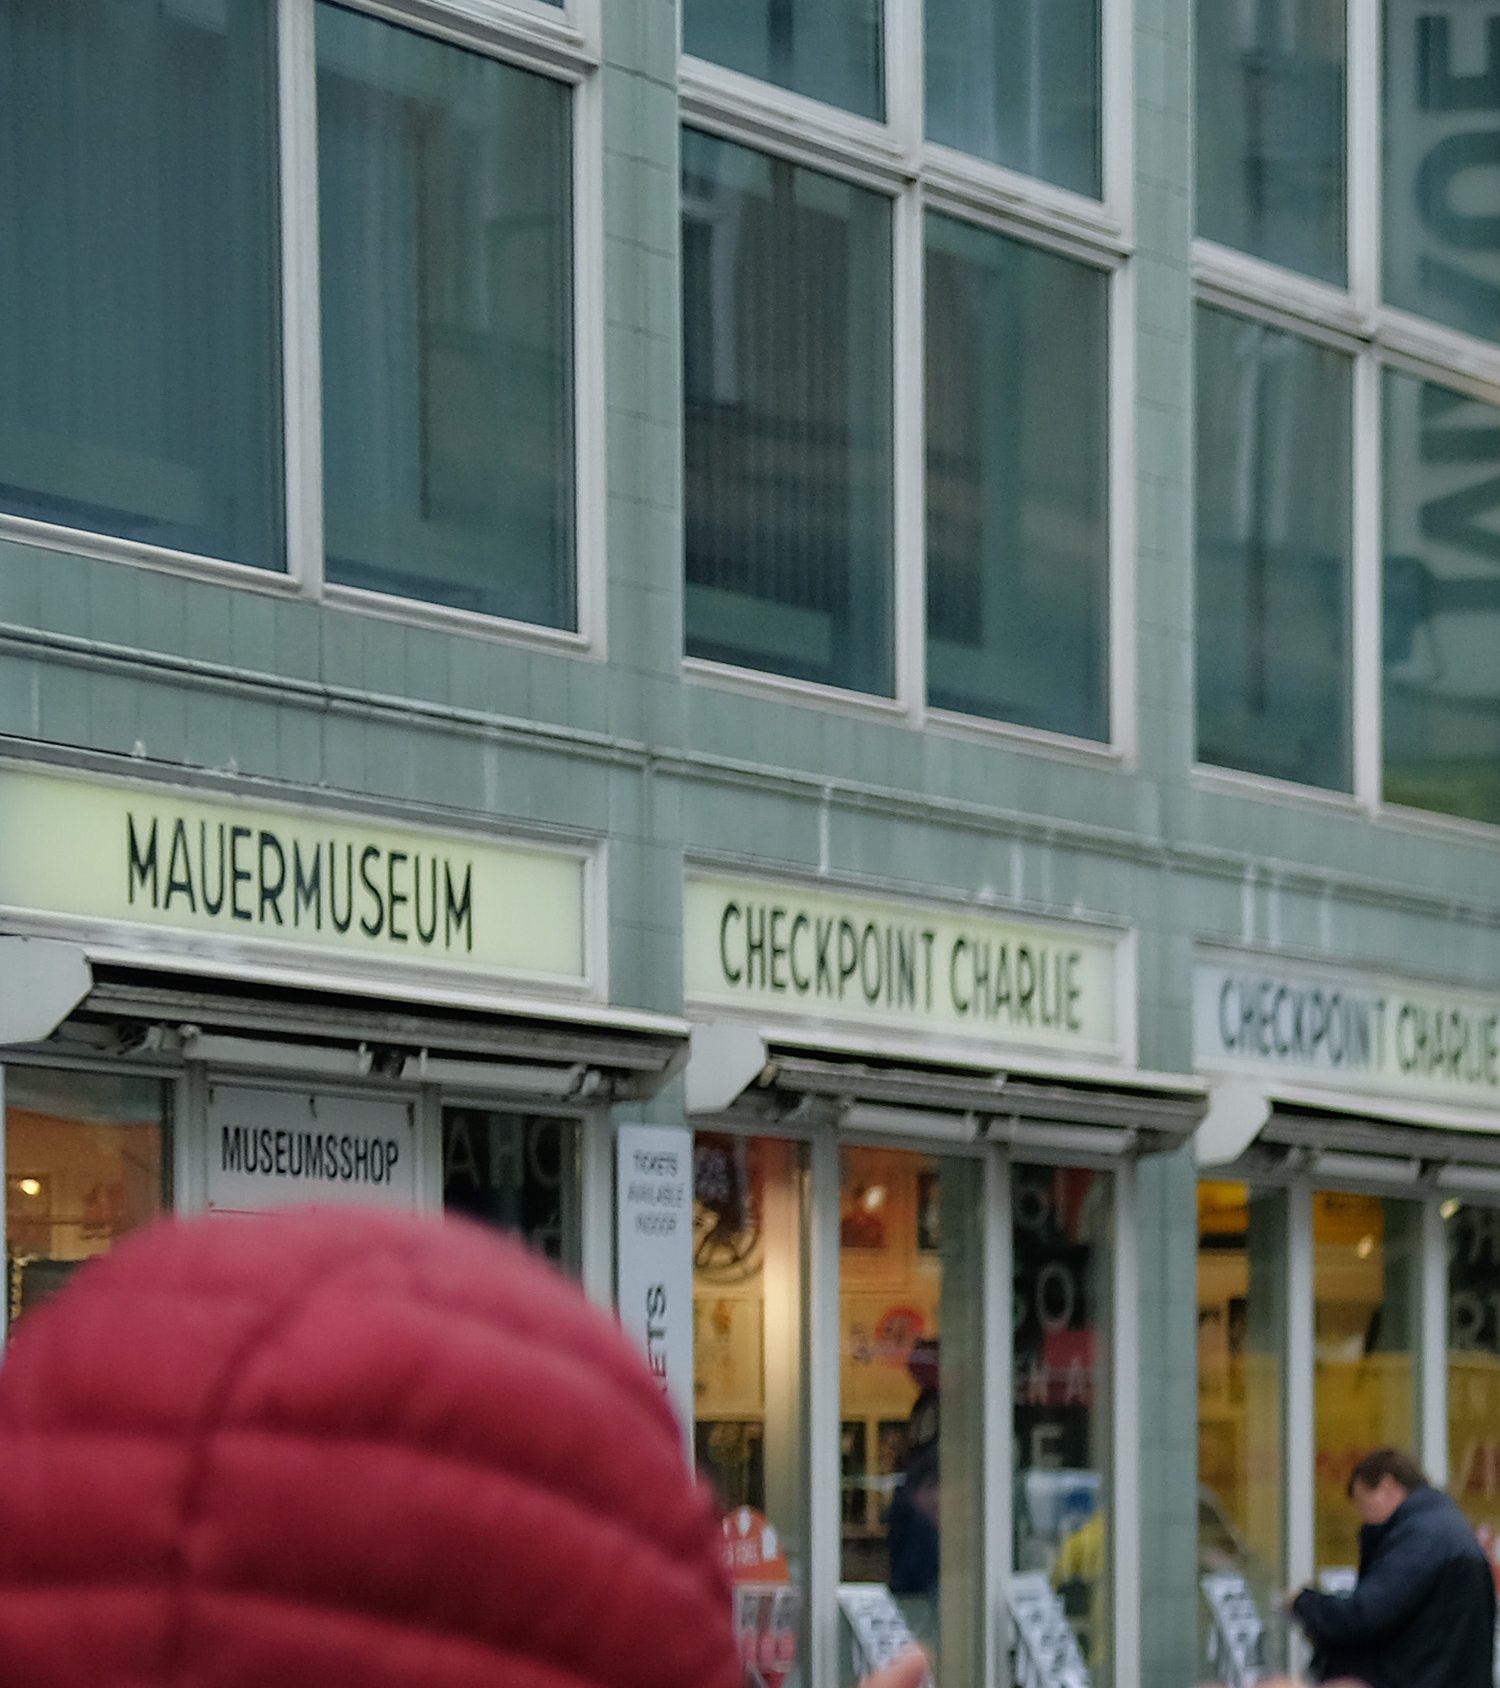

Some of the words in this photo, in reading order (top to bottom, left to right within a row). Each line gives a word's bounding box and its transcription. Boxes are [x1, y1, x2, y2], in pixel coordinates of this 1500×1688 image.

[126, 812, 474, 953] MAUERMUSEUM
[719, 900, 936, 1014] CHECKPOINT
[950, 935, 1083, 1033] CHARLIE
[1219, 975, 1386, 1073] CHECKPOINT
[1397, 1001, 1500, 1087] CHARLIE
[221, 1124, 399, 1187] MUSEUMSSHOP
